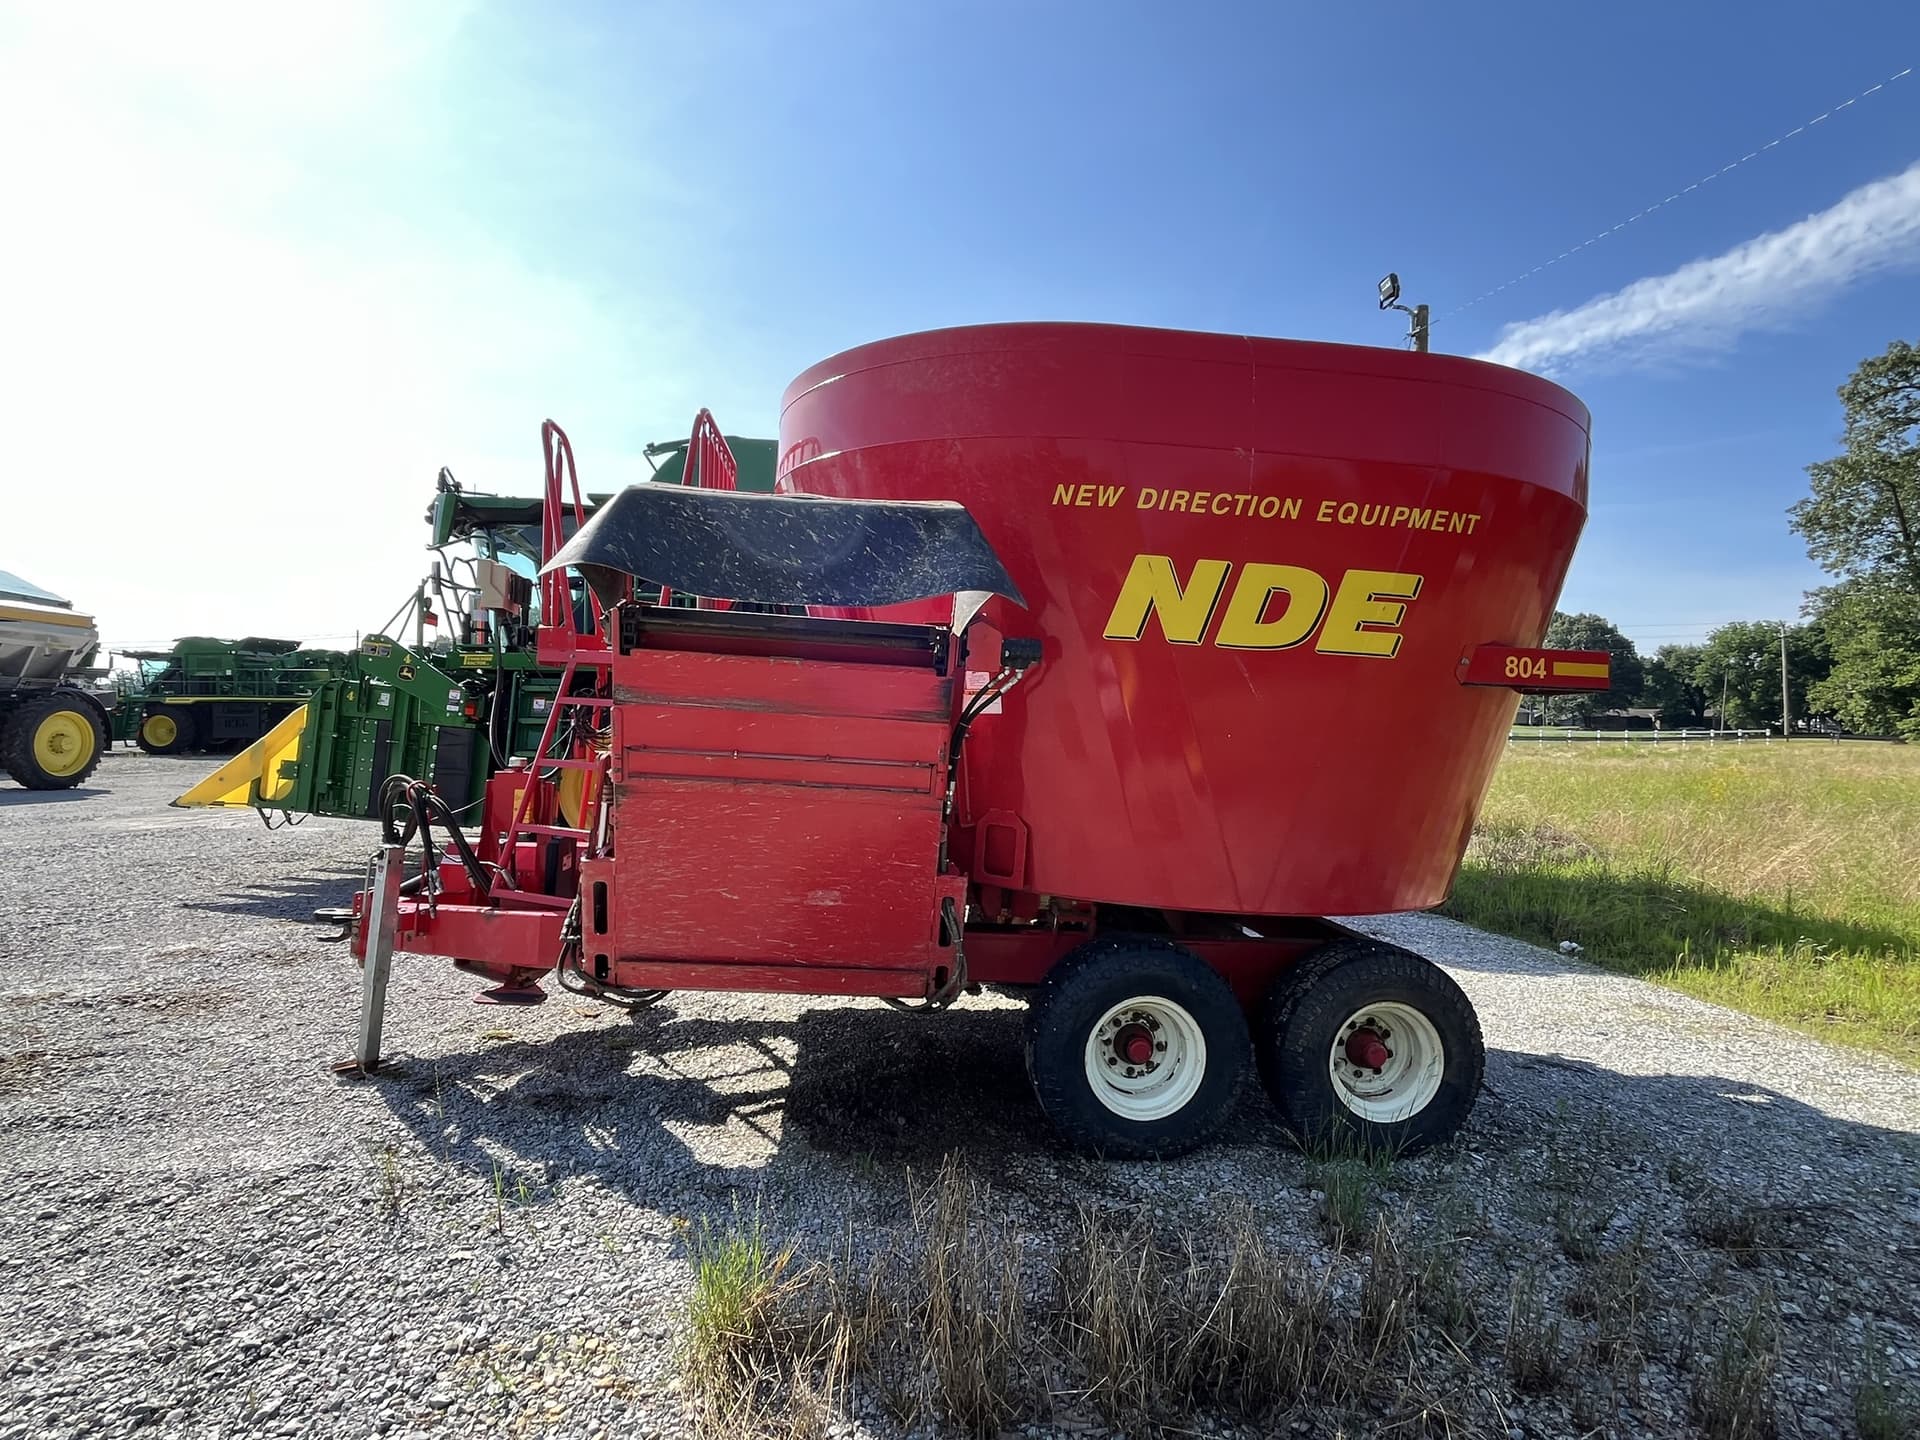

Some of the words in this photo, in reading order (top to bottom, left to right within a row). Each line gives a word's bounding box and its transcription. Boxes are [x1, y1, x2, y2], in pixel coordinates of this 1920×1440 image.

[1051, 483, 1125, 507] NEW
[1136, 487, 1303, 520] DIRECTION
[1316, 500, 1481, 535] EQUIPMENT
[1102, 553, 1424, 659] NDE
[1504, 655, 1547, 679] 804
